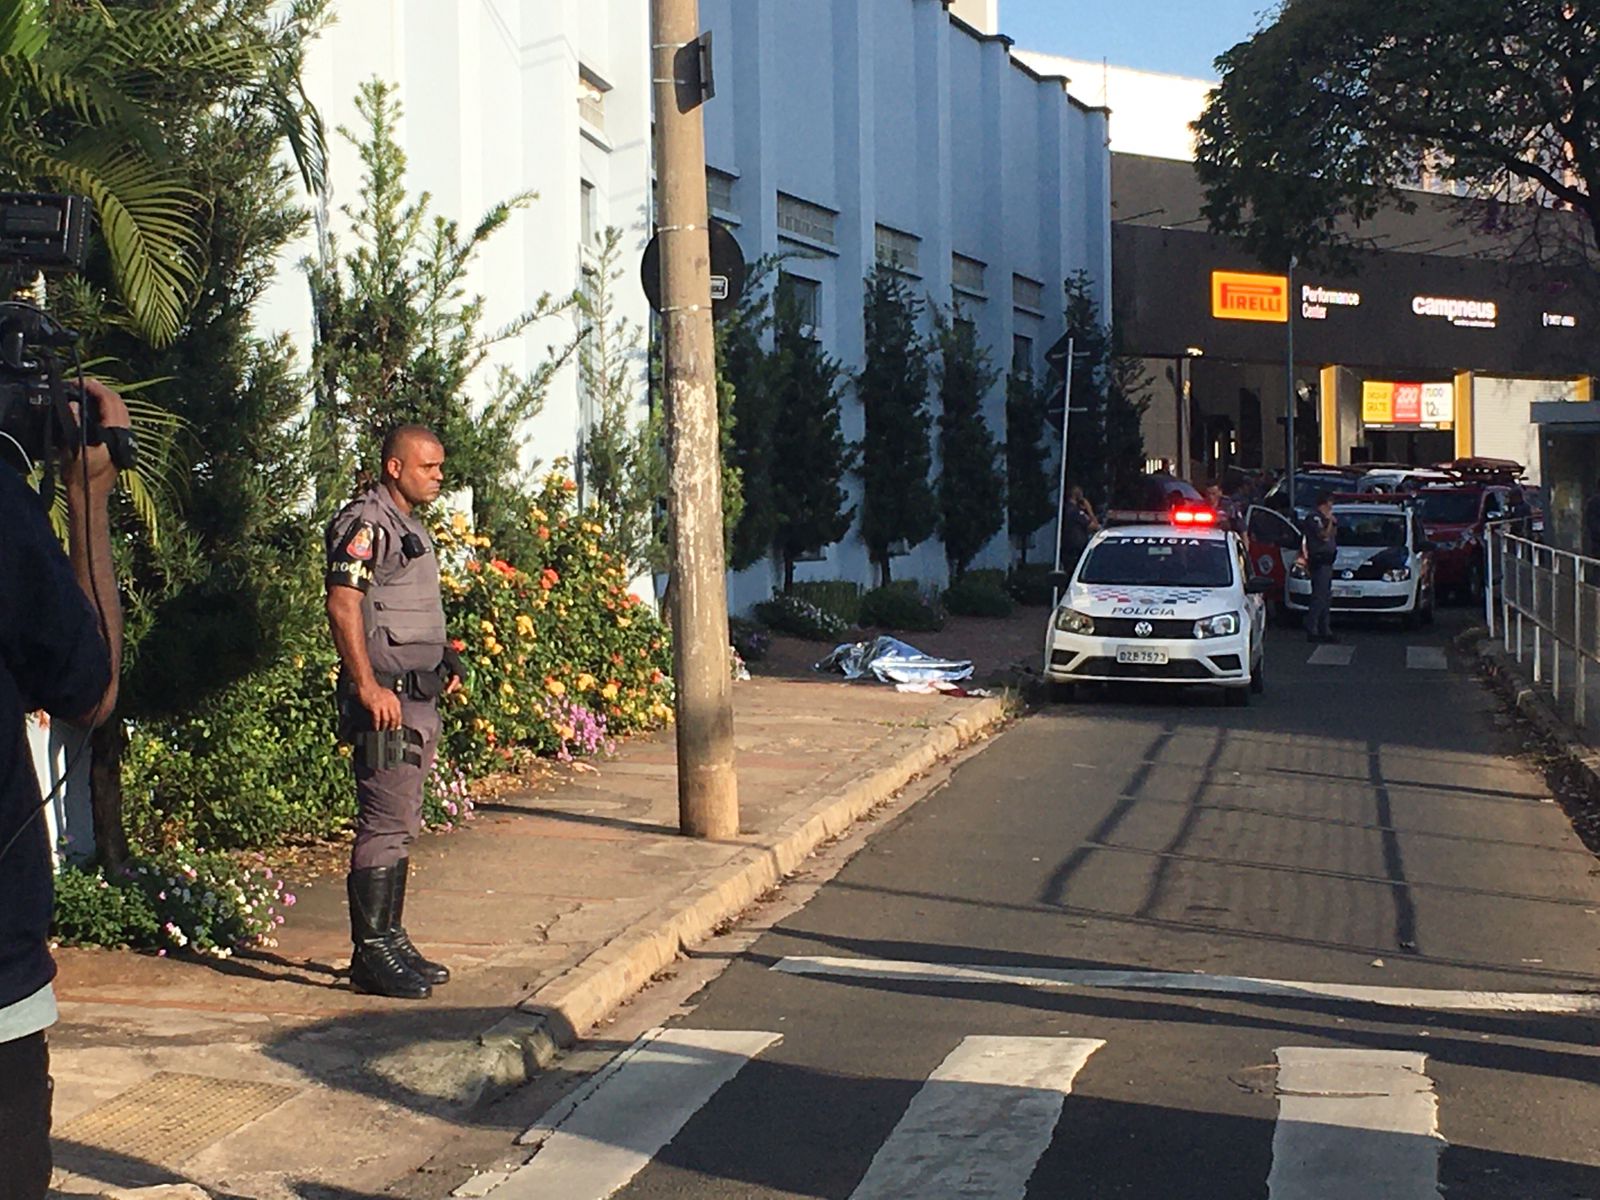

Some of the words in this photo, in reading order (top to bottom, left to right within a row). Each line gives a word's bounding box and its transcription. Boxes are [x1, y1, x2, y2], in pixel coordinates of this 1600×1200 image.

[1221, 282, 1282, 312] PIRELLI
[1412, 296, 1496, 321] campneus
[1111, 606, 1175, 616] POLÍCIA
